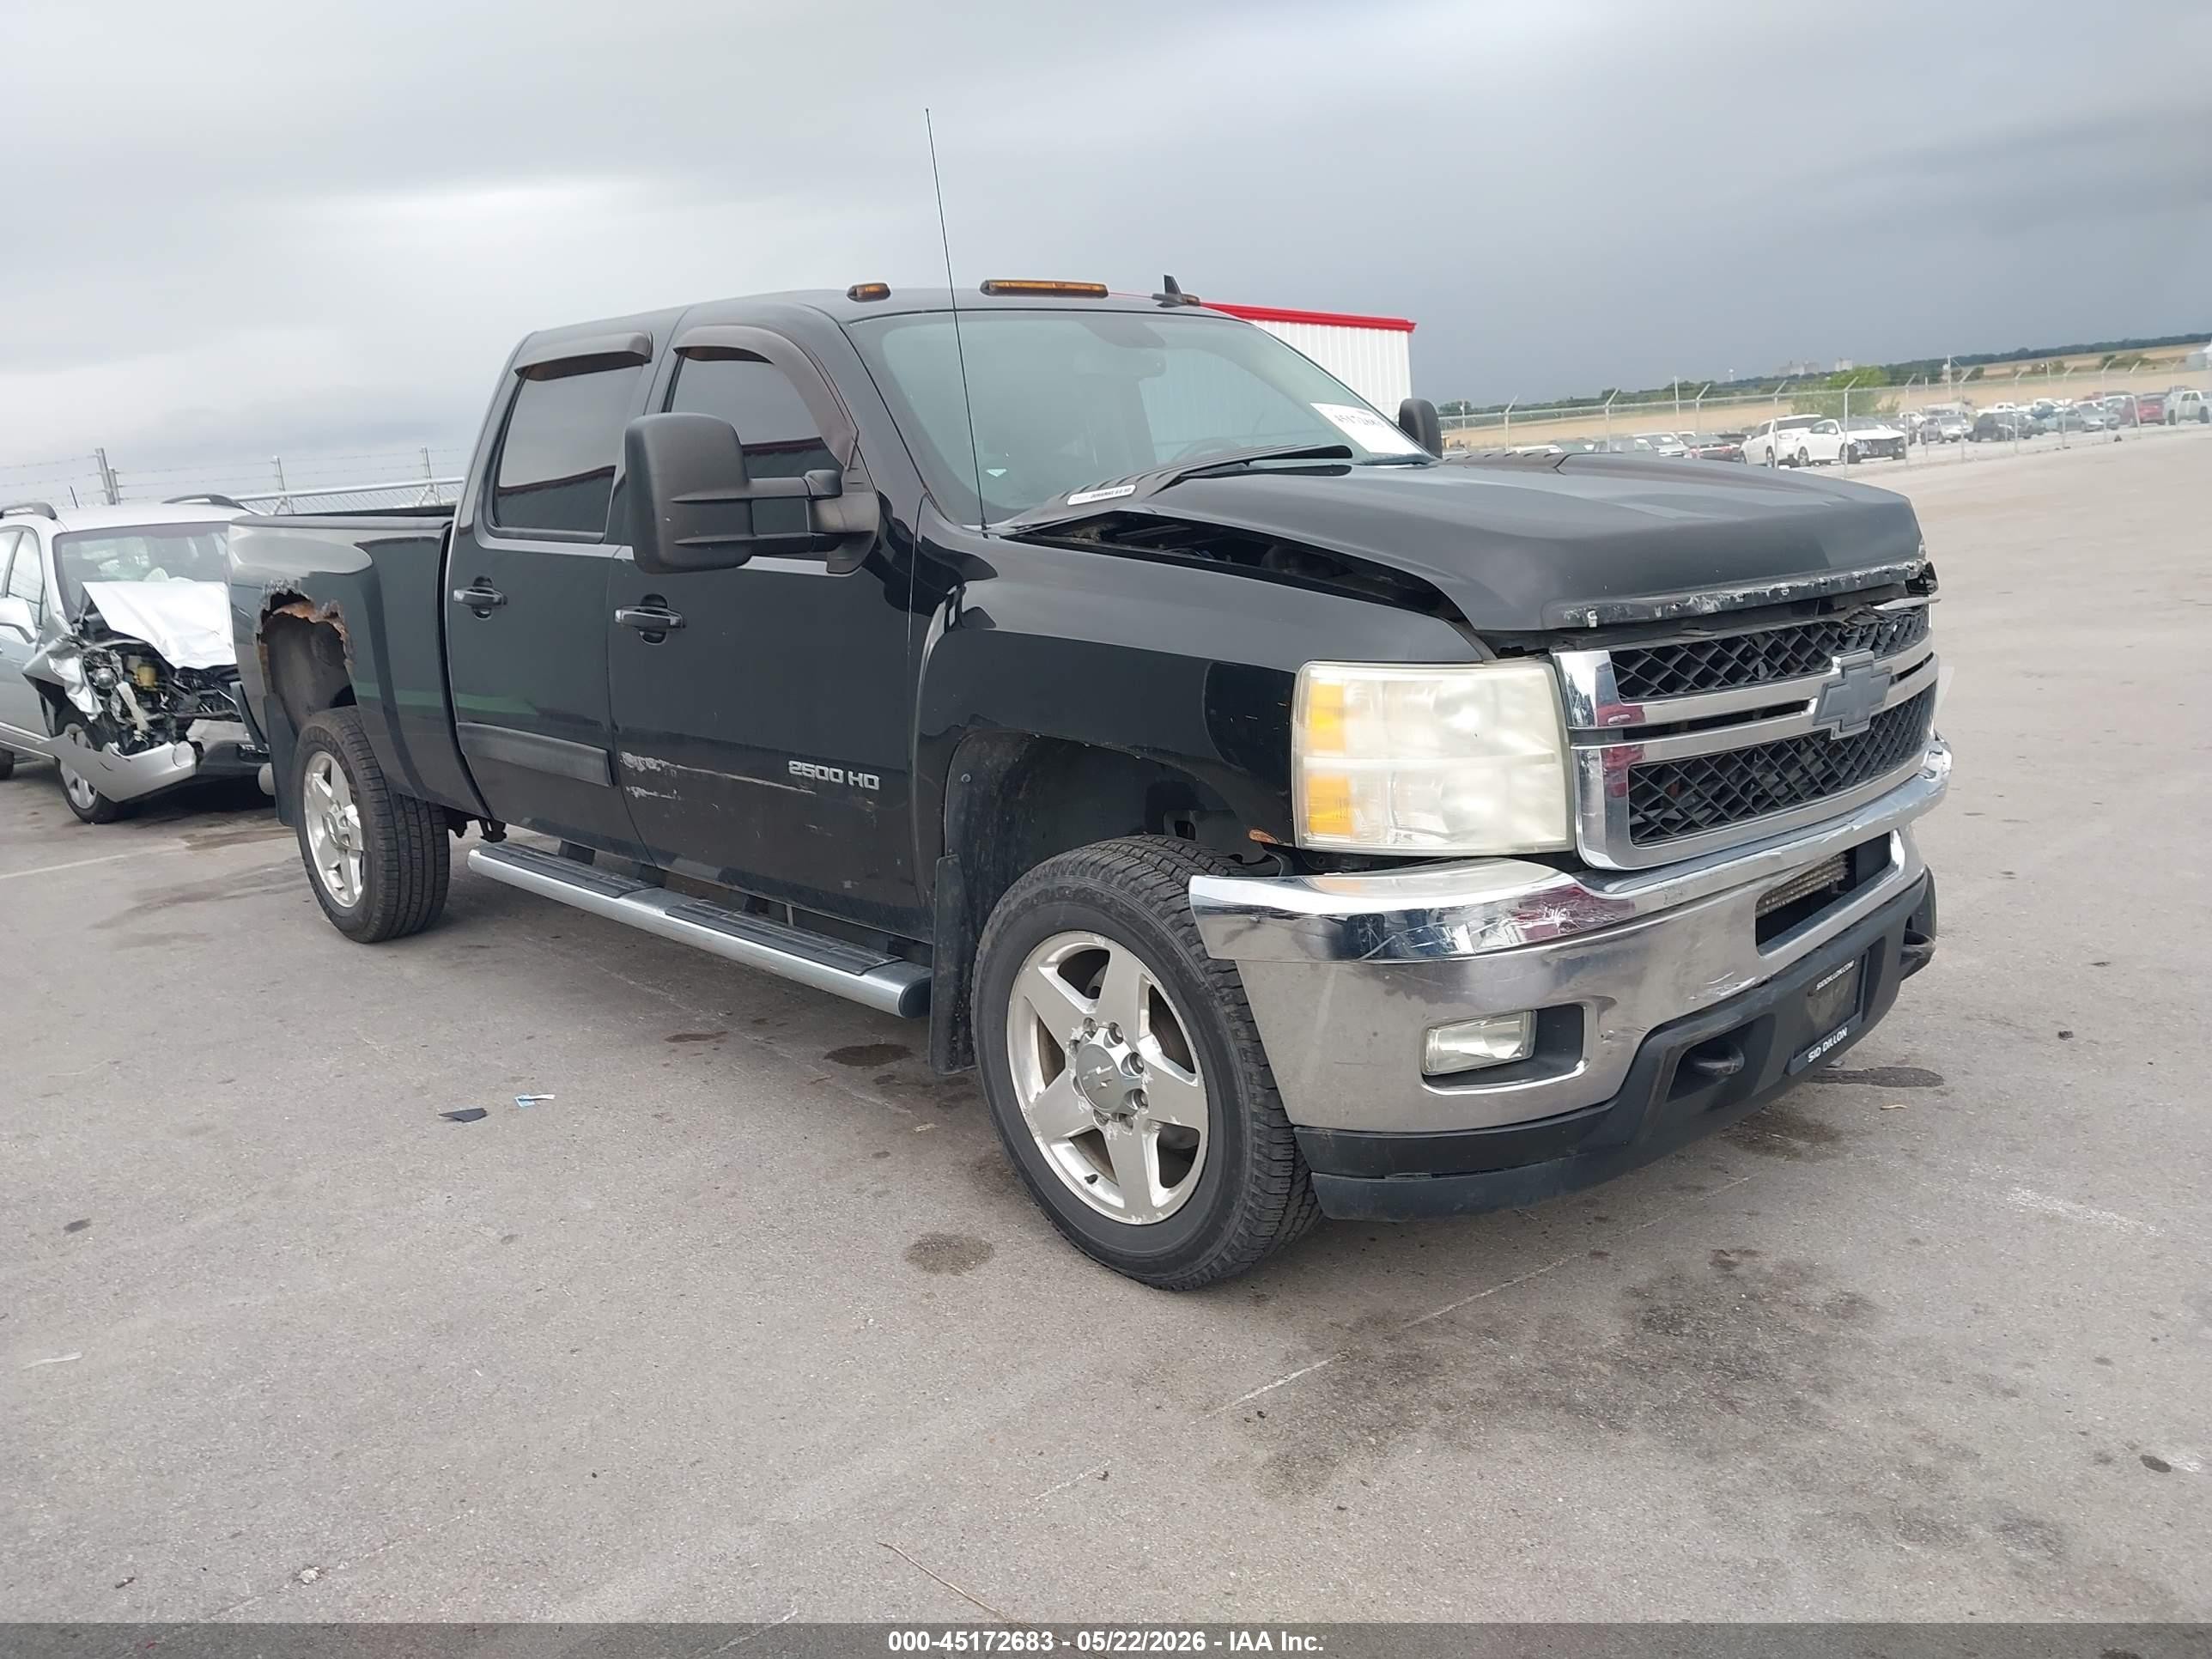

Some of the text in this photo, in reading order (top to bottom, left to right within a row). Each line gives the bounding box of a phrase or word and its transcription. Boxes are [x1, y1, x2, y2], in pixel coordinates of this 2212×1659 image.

[788, 760, 879, 790] 2500 HD
[1808, 1026, 1848, 1063] SID DILLON
